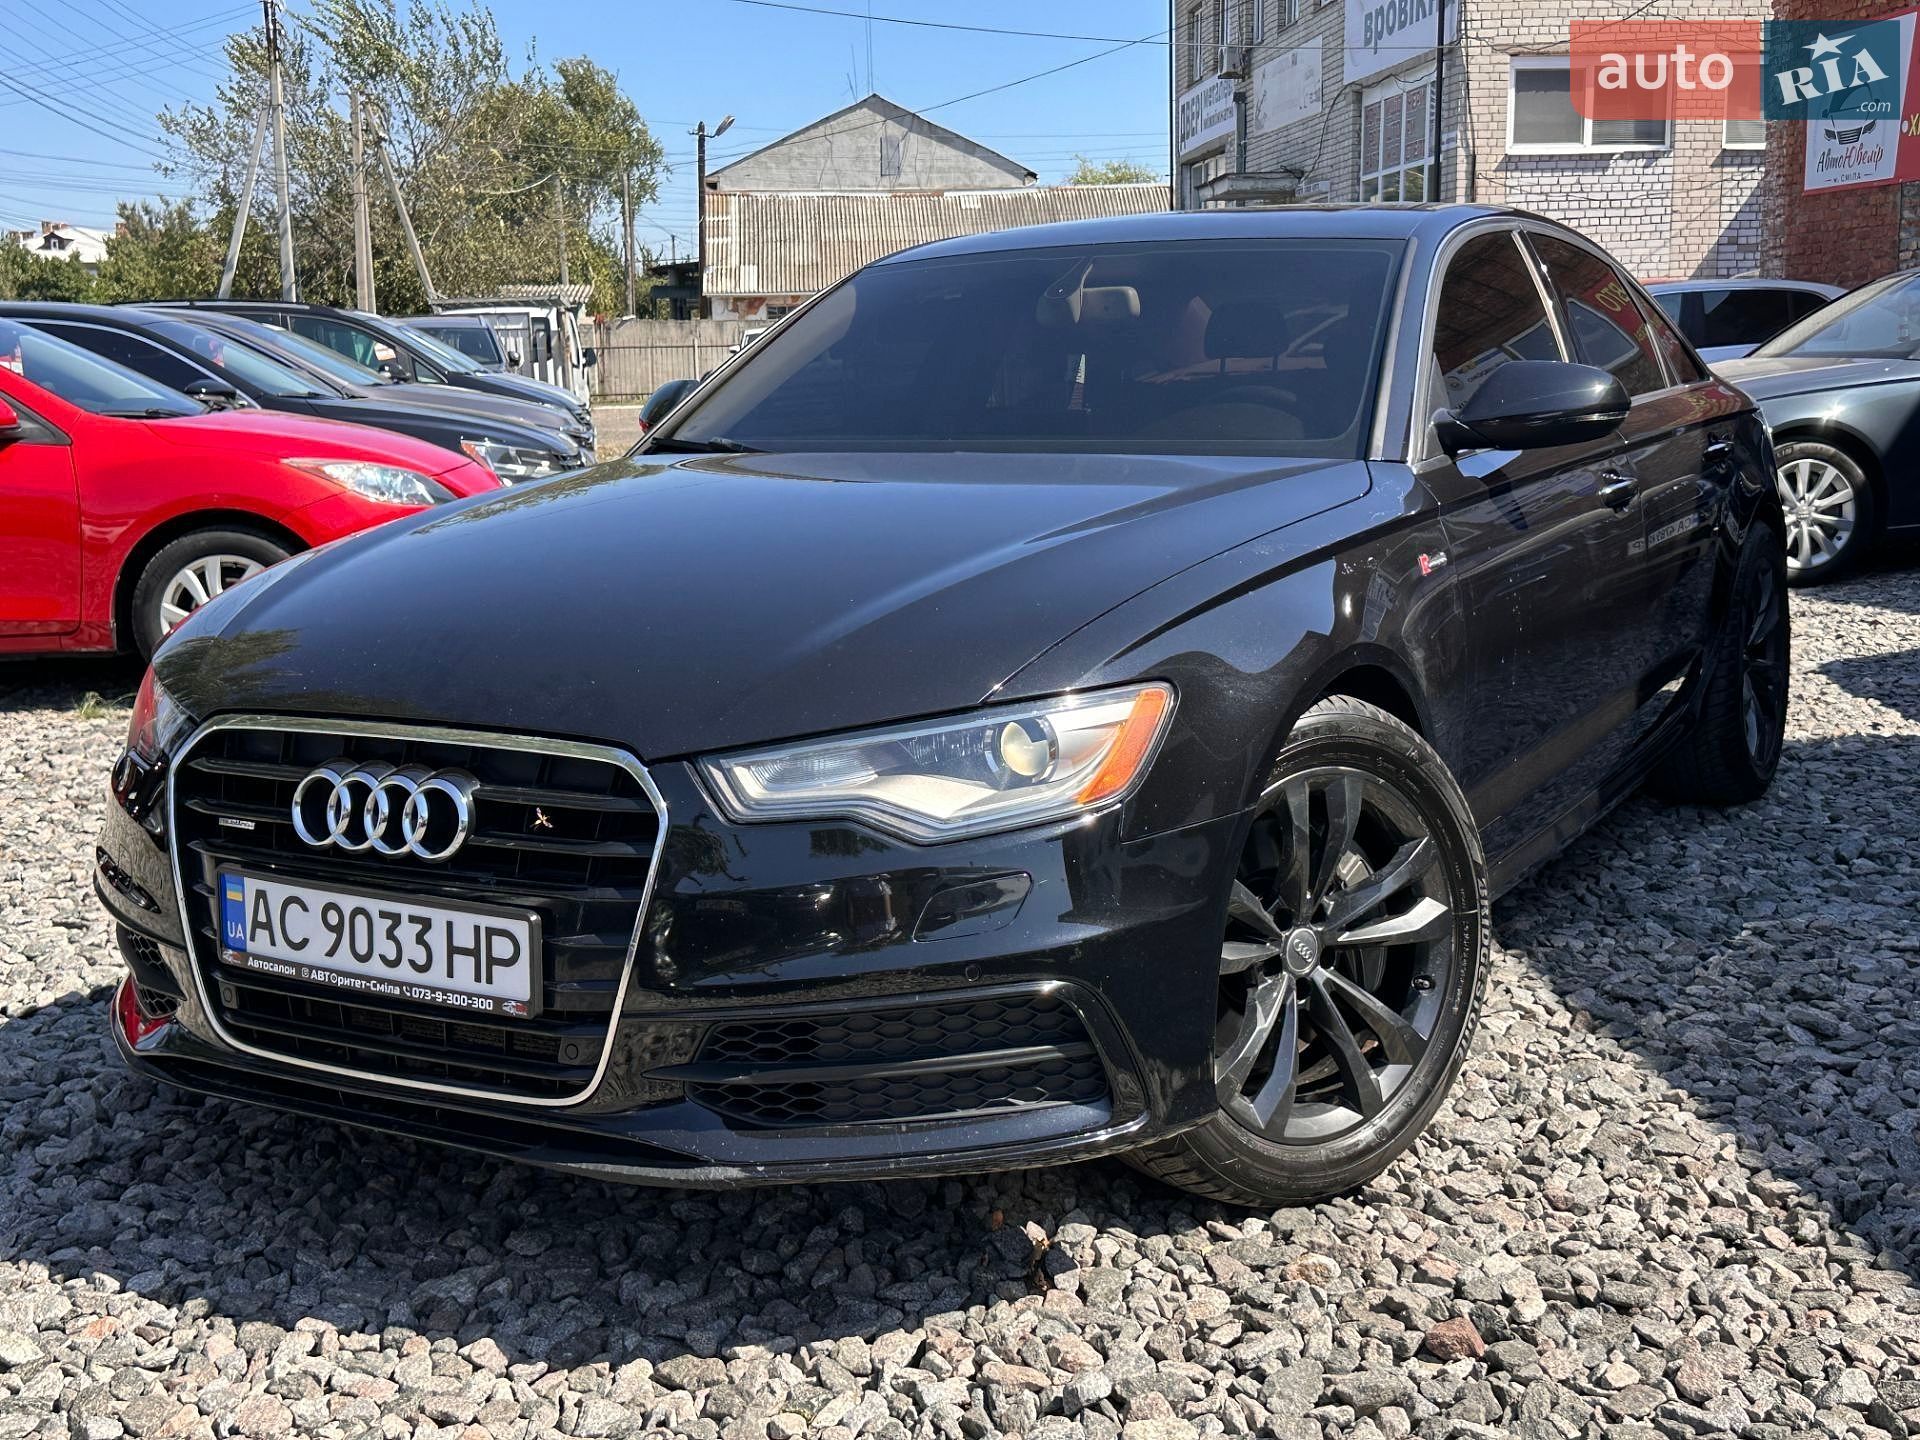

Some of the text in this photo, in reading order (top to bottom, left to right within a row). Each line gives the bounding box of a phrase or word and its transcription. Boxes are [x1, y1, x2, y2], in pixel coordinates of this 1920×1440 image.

[227, 920, 245, 941] UA
[249, 889, 521, 985] AC 9033 HP
[247, 956, 296, 976] Автосалон
[411, 987, 494, 1011] 073-9-300-300
